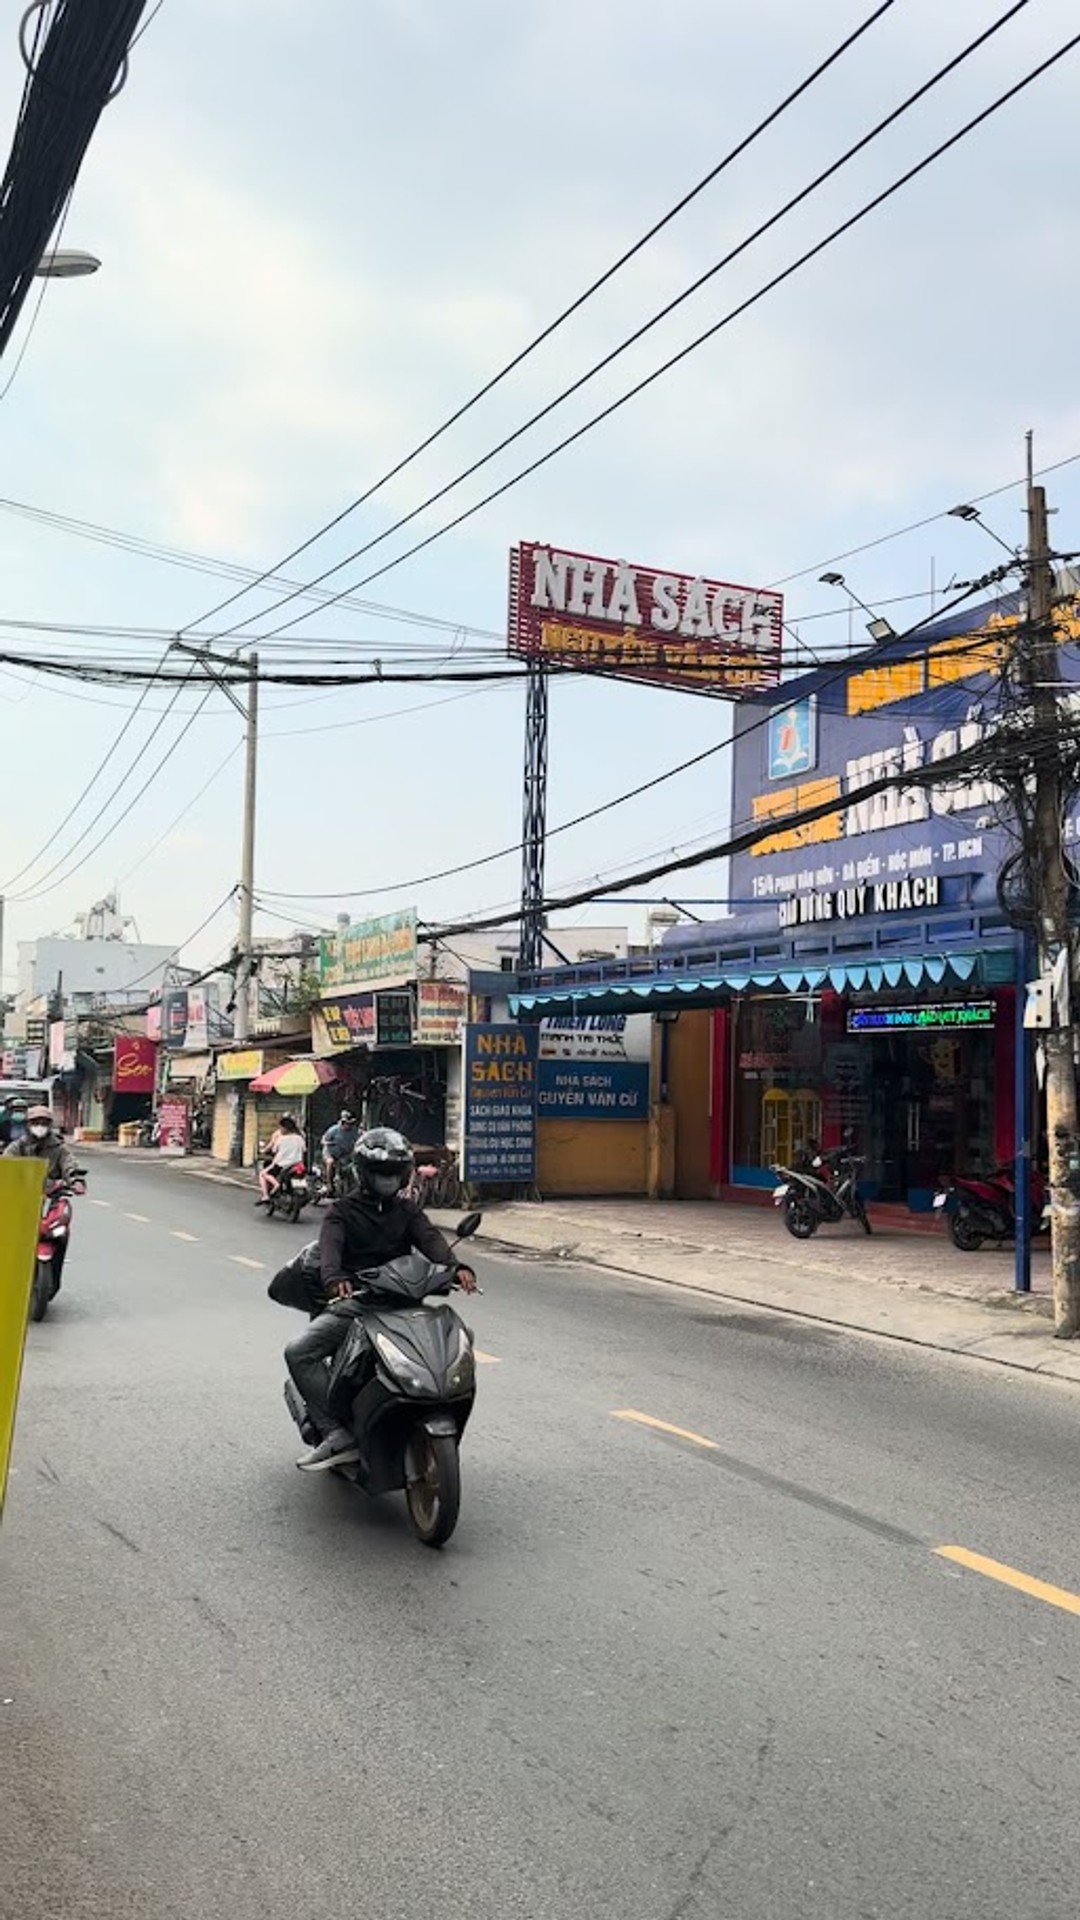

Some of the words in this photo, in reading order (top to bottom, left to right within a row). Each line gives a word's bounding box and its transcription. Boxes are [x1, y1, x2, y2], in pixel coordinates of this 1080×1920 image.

[530, 549, 642, 625] NHÀ
[650, 575, 774, 650] SÁCH
[958, 837, 982, 860] HCM
[800, 887, 833, 923] MỪNG
[837, 879, 866, 920] QUÝ
[874, 872, 938, 912] KHÁCH
[477, 1028, 527, 1054] NHÀ
[471, 1056, 533, 1081] SÁCH
[556, 1072, 579, 1086] NHÀ
[583, 1071, 612, 1087] SÁCH
